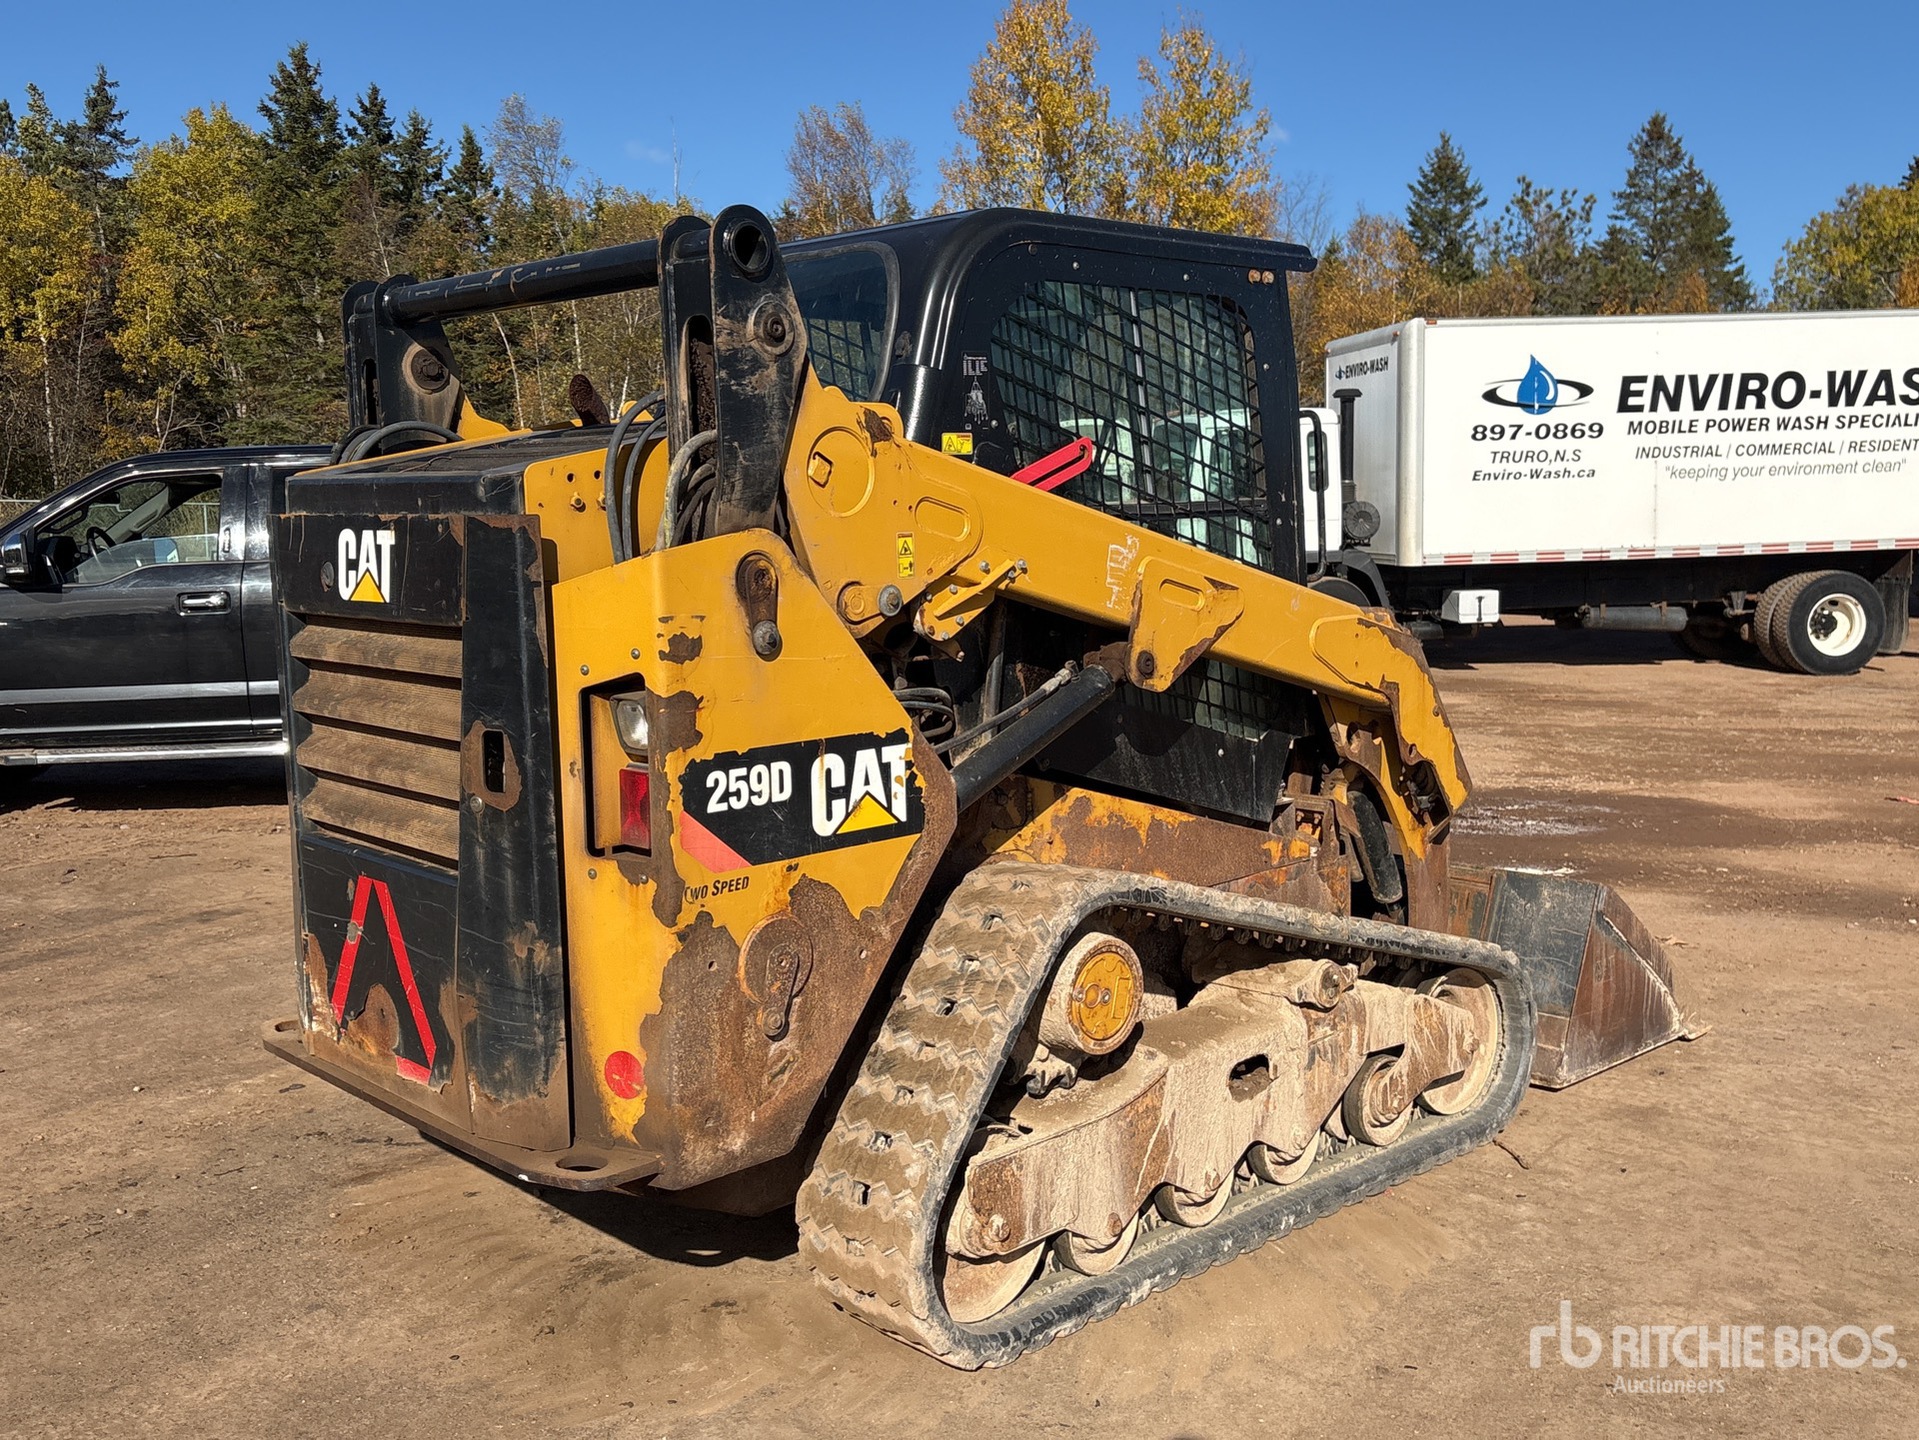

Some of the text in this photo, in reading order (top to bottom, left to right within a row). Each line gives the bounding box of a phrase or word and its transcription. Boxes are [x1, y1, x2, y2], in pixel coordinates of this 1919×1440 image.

[1345, 356, 1389, 379] ENVIRO-WASH
[1617, 367, 1919, 413] ENVIRO-WAS
[1471, 422, 1604, 441] 897-0869
[1627, 419, 1699, 435] MOBILE
[1705, 417, 1770, 433] POWER
[1776, 415, 1829, 431] WASH
[1635, 445, 1722, 459] INDUSTRIAL
[1735, 441, 1835, 457] COMMERCIAL
[1472, 467, 1596, 481] Enviro-Wash.ca
[1665, 457, 1907, 482] "keeping your environment clean"
[337, 528, 396, 603] CAT
[706, 760, 793, 814] 259D
[811, 743, 912, 837] CAT
[711, 876, 749, 896] SPEED
